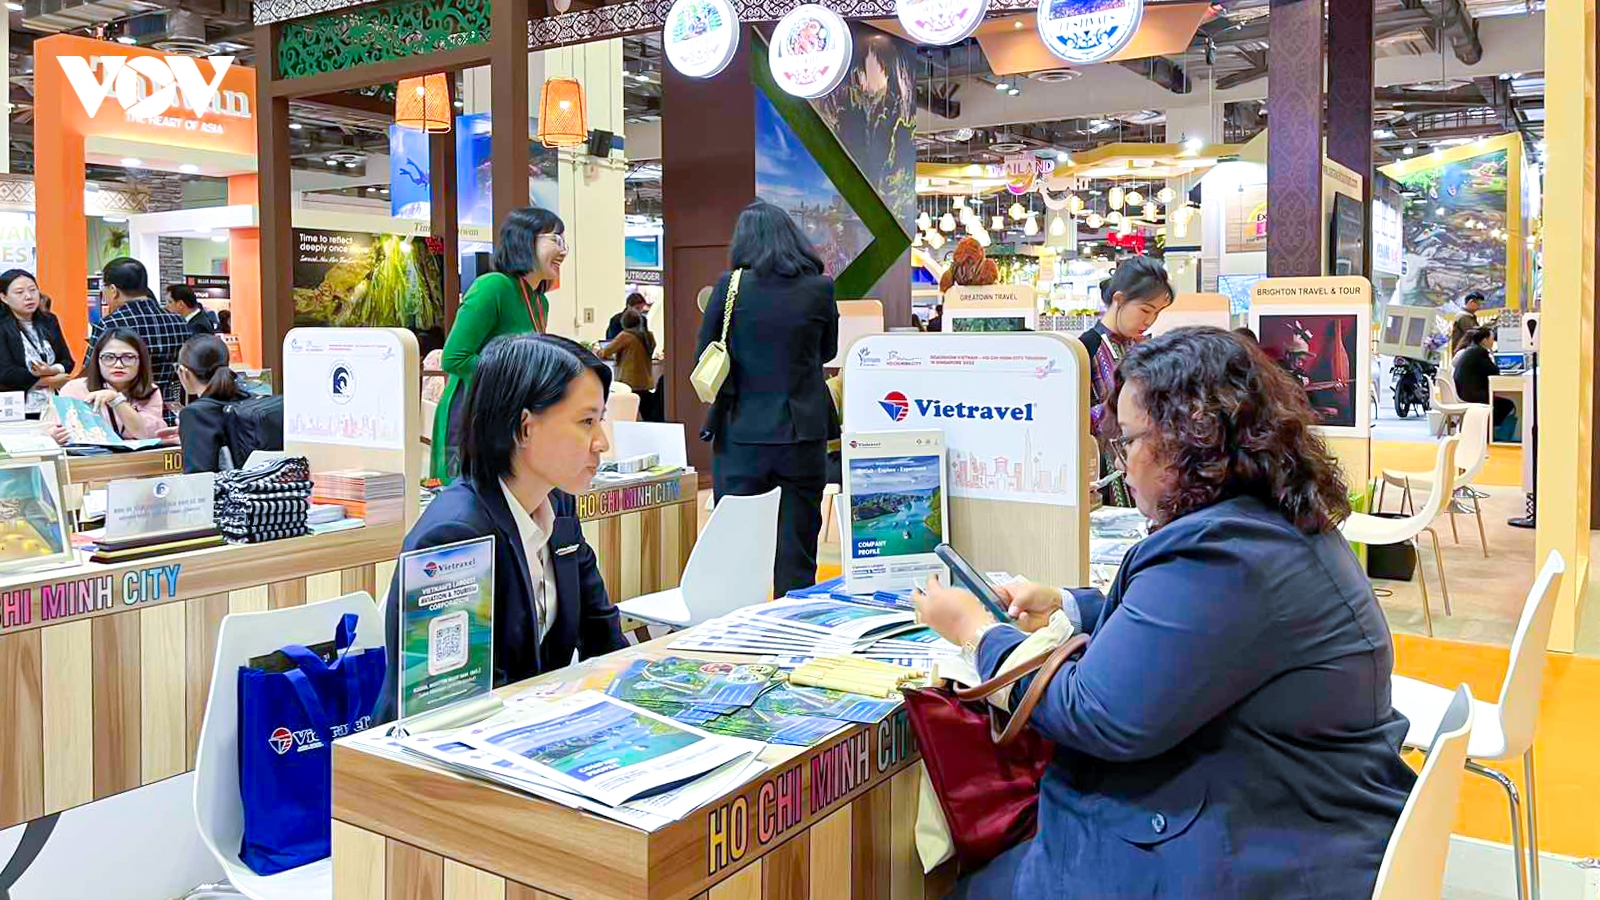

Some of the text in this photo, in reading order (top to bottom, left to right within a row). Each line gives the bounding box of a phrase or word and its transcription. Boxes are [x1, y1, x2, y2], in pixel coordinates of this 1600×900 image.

[148, 115, 182, 128] HEART
[184, 120, 198, 131] OF
[200, 121, 225, 134] ASIA
[299, 233, 353, 245] Time to reflect
[299, 242, 328, 253] deeply
[328, 245, 348, 253] once
[995, 293, 1018, 301] TRAVEL
[1256, 286, 1361, 296] BRIGHTON TRAVEL & TOUR
[914, 399, 1034, 421] Vietravel
[164, 452, 183, 471] HO
[579, 480, 680, 518] HO CHI MINH CITY
[858, 540, 887, 548] COMPANY
[438, 558, 476, 571] Vietravel
[0, 564, 181, 628] HI MINH CITY
[709, 708, 918, 876] HO CHI MINH CIT
